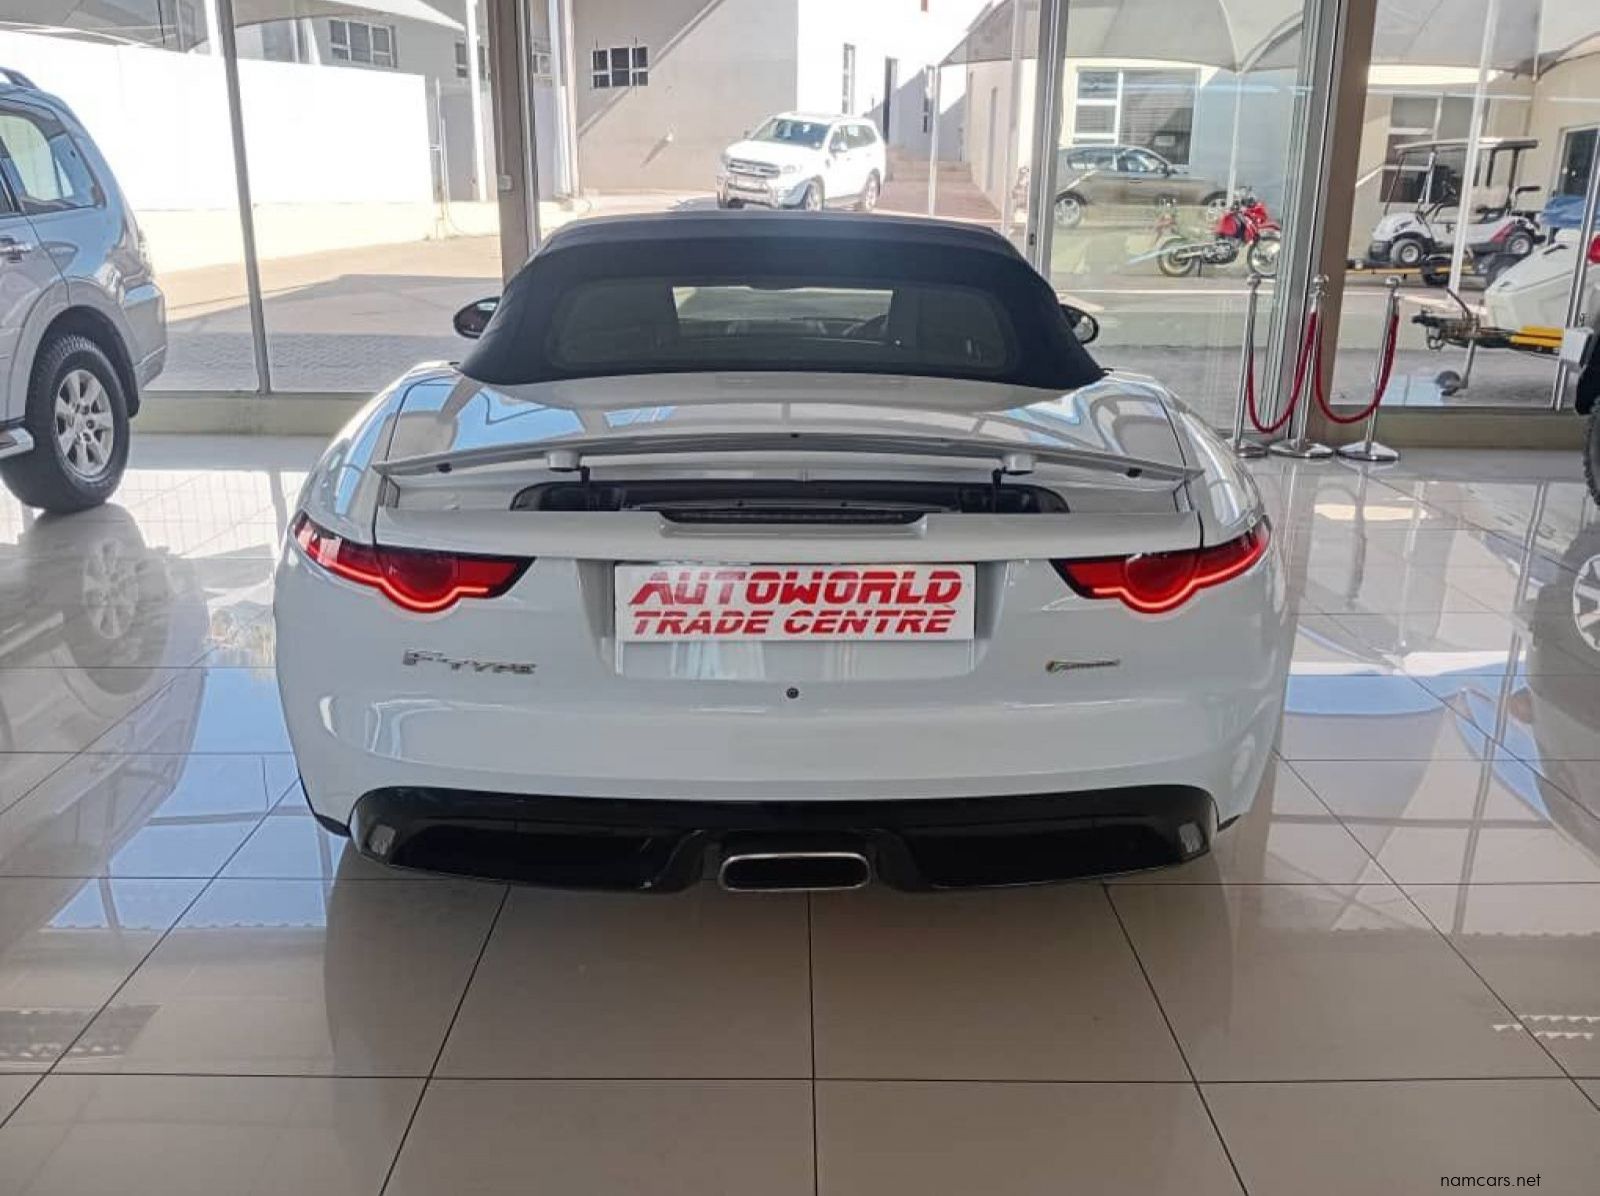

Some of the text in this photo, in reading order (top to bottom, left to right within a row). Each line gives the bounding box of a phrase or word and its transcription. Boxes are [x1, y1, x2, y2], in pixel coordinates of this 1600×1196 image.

[628, 569, 963, 605] AUTOWORLD
[633, 608, 956, 635] TRADE CENTRE
